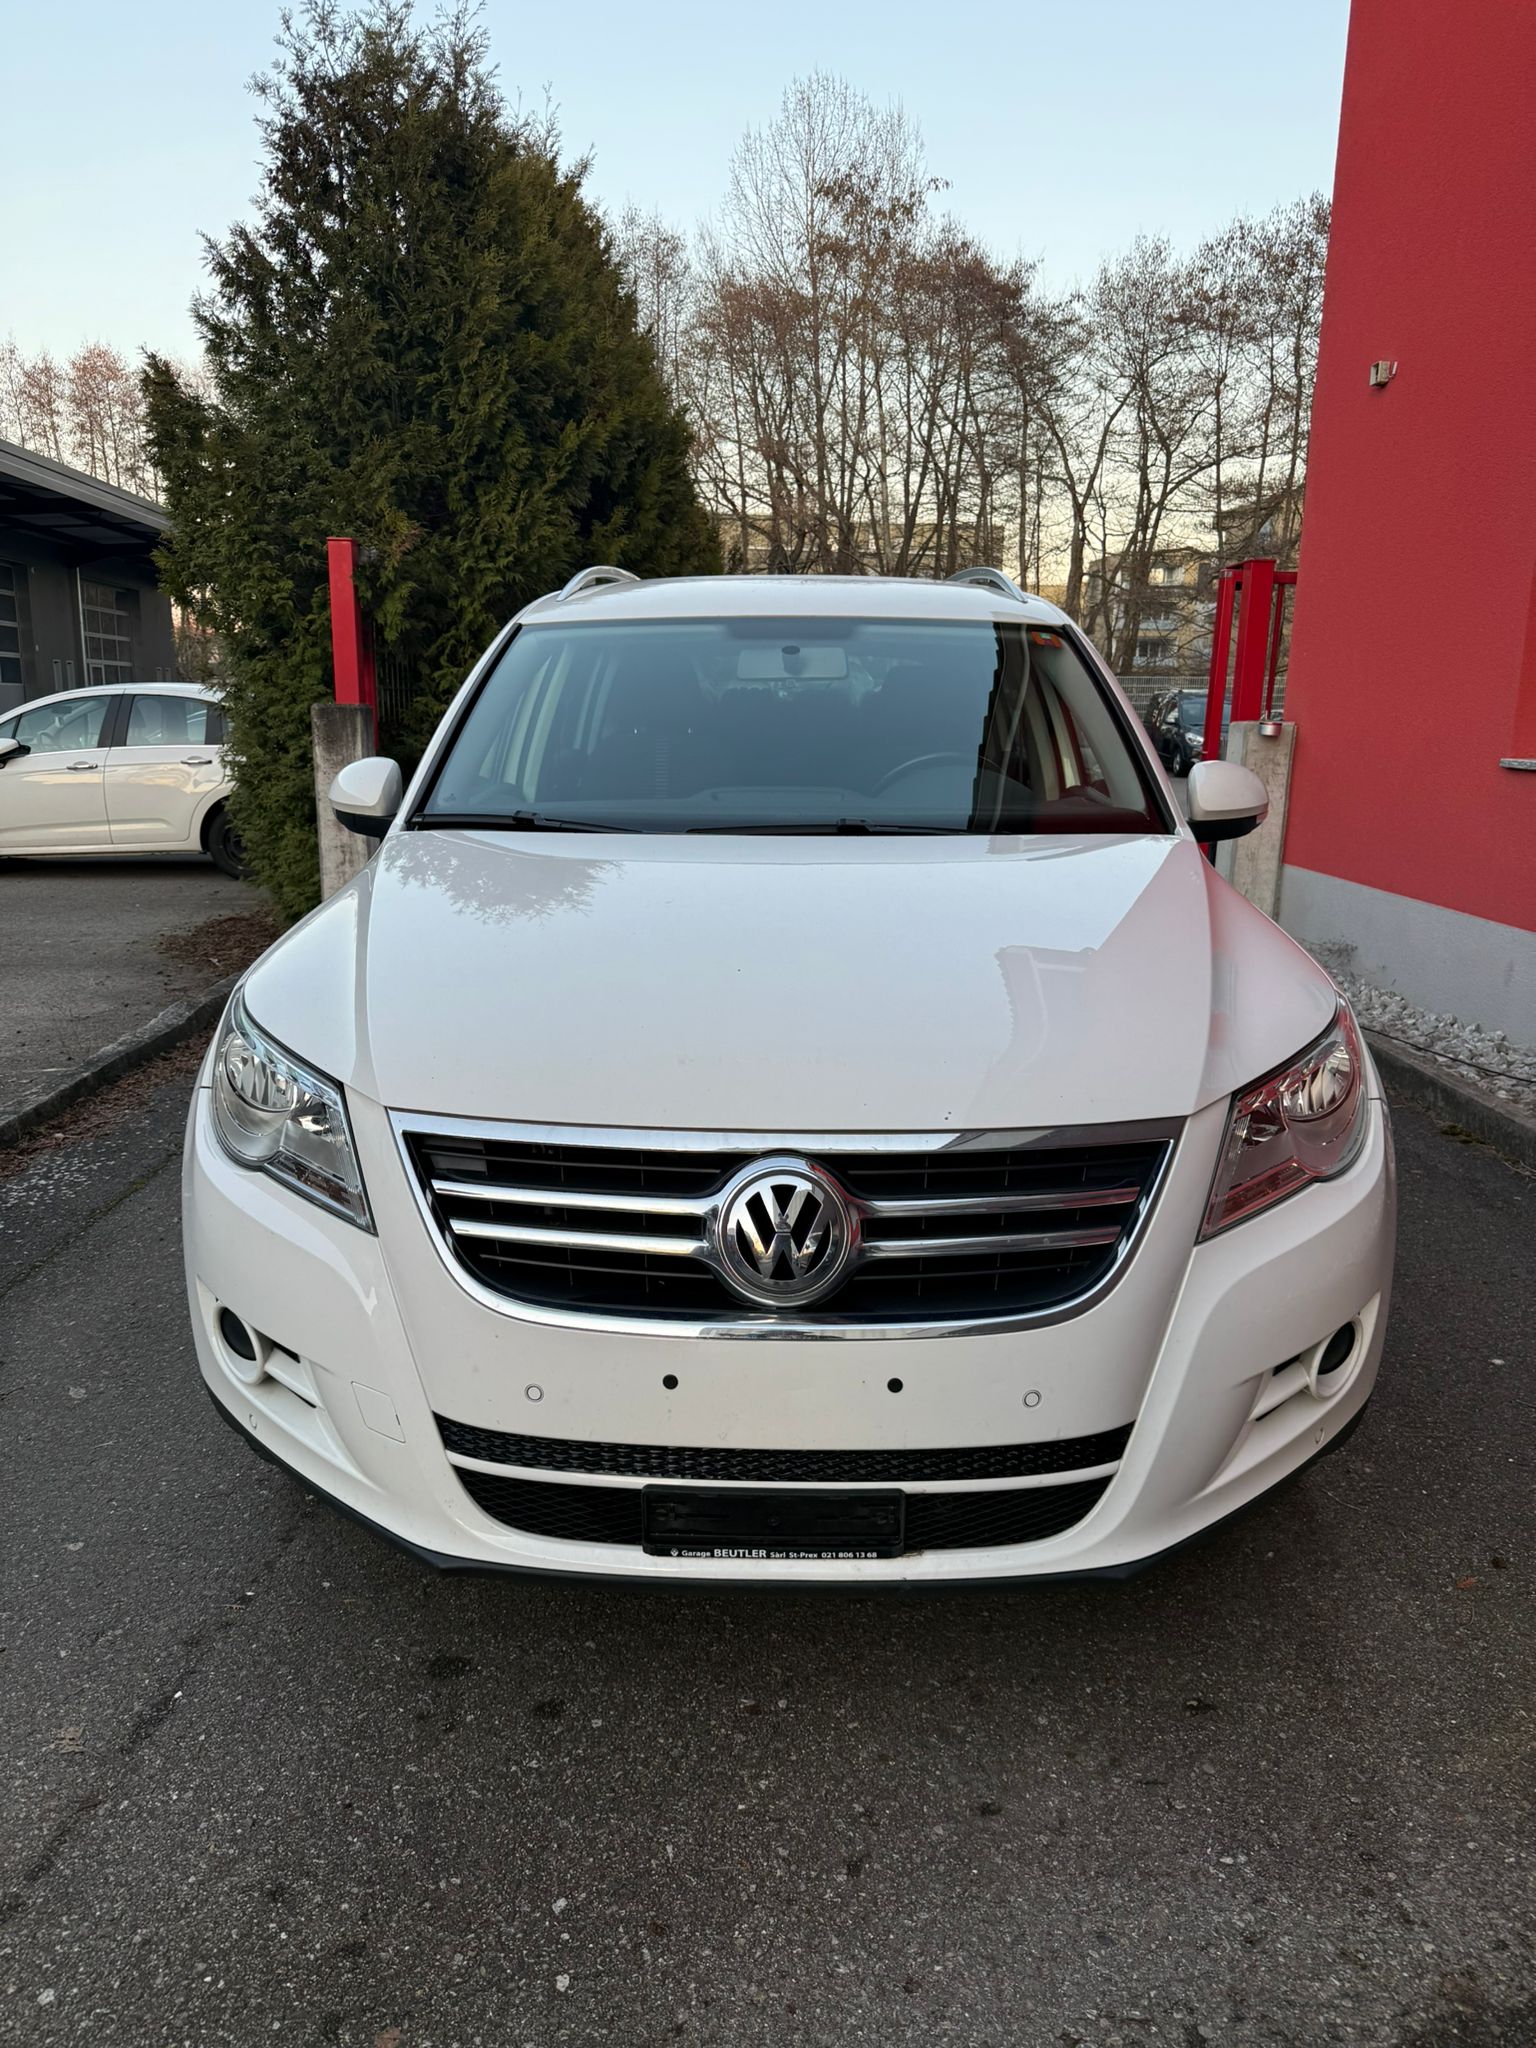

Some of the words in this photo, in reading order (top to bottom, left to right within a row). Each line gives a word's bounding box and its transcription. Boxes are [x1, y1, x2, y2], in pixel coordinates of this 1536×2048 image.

[731, 1176, 836, 1285] VW
[681, 1549, 711, 1558] Garage
[713, 1548, 767, 1558] BEUTLER
[788, 1551, 818, 1559] St-Prex
[821, 1551, 836, 1559] 021
[838, 1551, 854, 1559] 806
[855, 1551, 865, 1559] 13
[866, 1551, 878, 1559] 68
